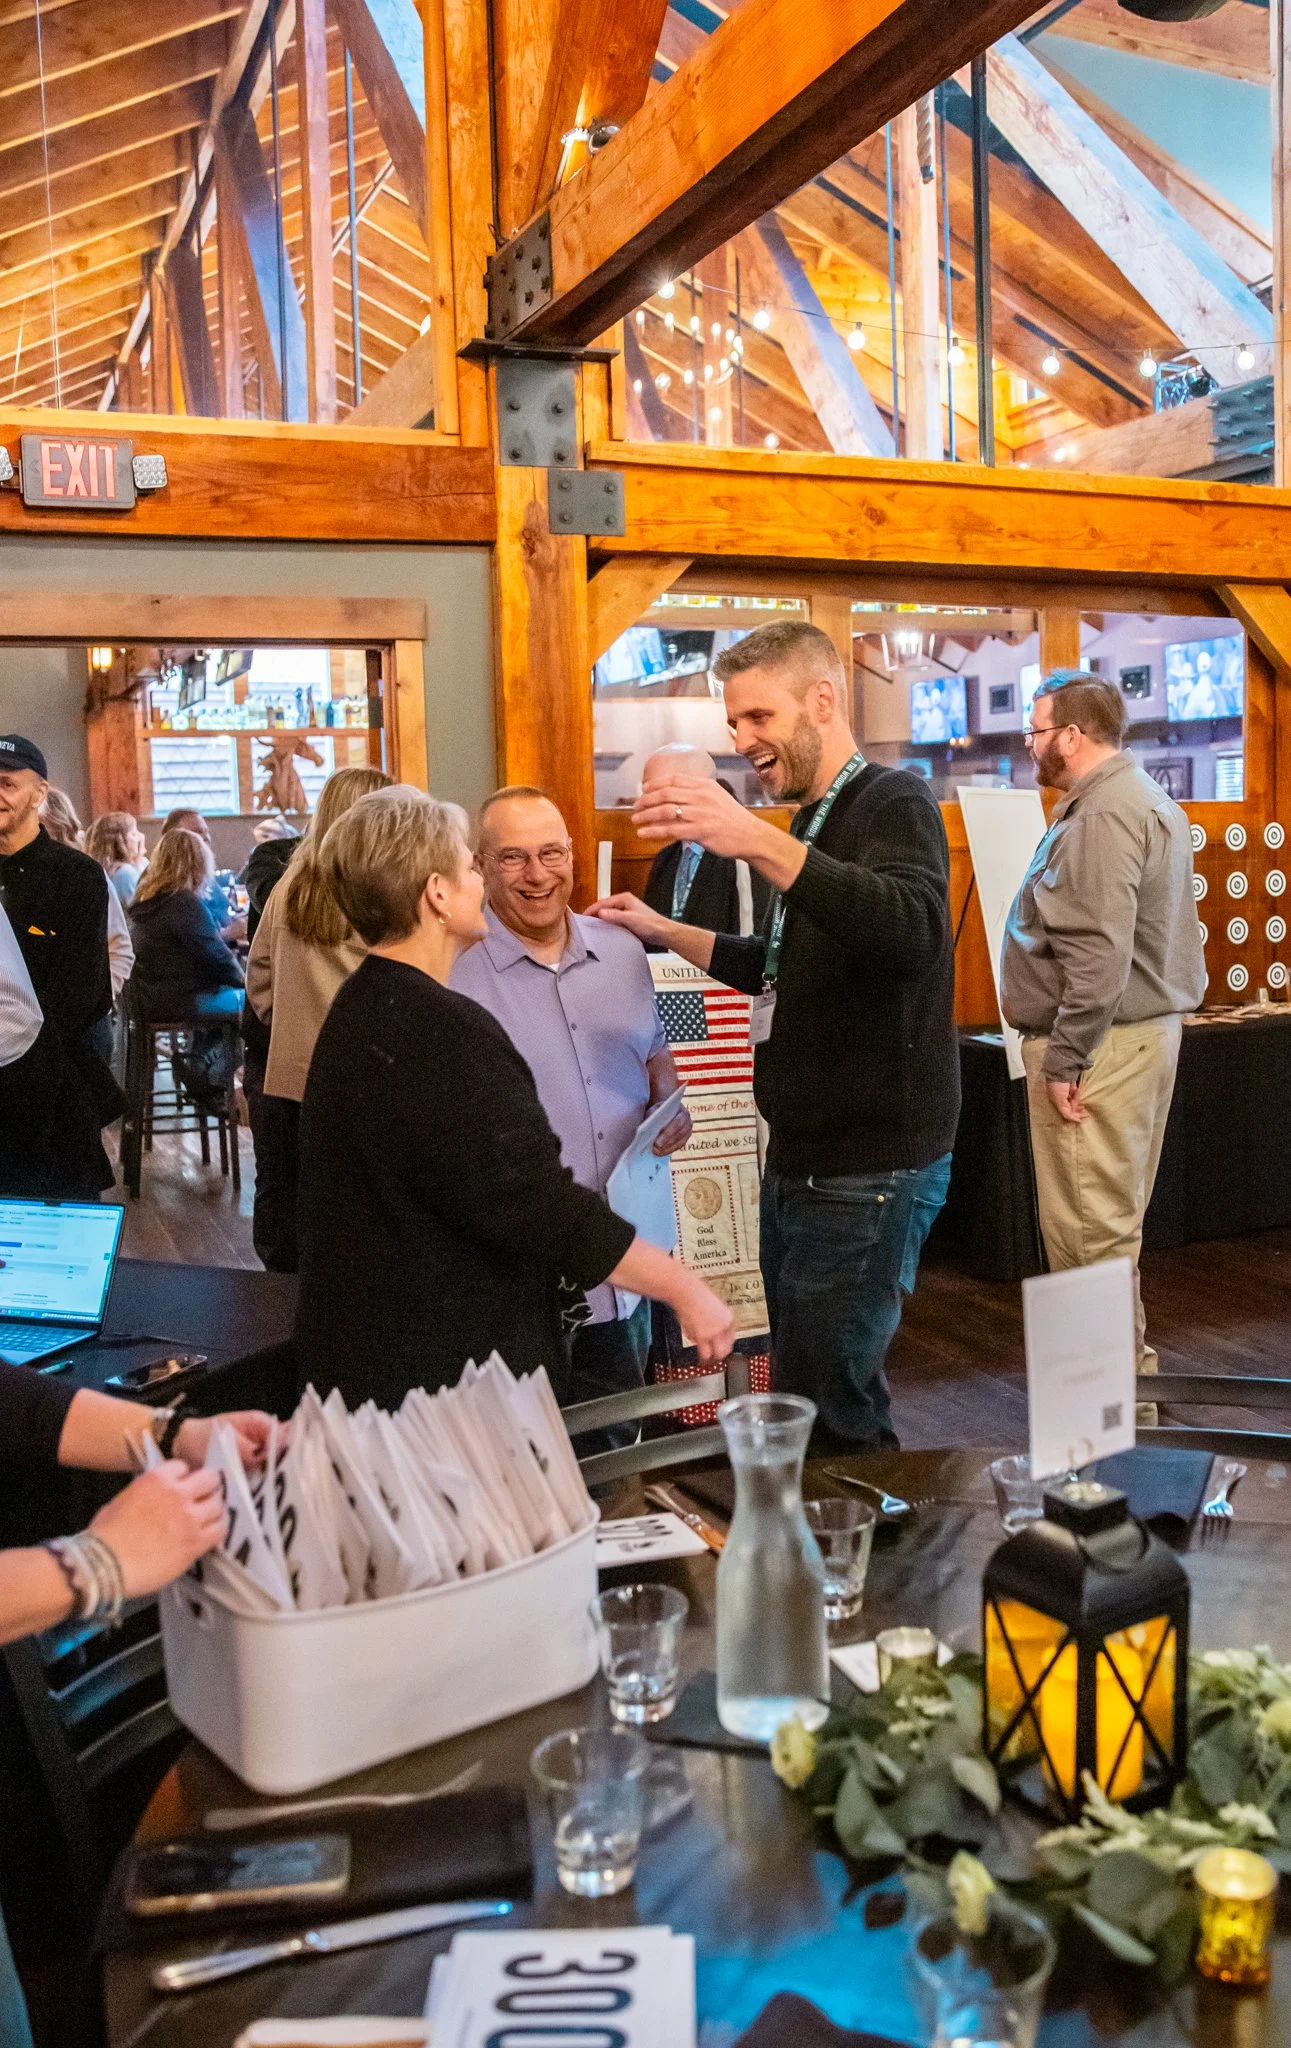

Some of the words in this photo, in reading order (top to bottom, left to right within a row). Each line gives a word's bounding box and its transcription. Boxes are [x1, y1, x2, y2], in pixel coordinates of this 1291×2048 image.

[40, 440, 118, 498] EXIT
[846, 761, 857, 772] THE
[832, 770, 850, 789] WOODS
[818, 803, 829, 816] THE
[808, 815, 823, 838] WOODS
[716, 1100, 729, 1112] of
[731, 1099, 748, 1109] the
[724, 1139, 739, 1147] we
[696, 1224, 714, 1234] God
[697, 1238, 717, 1248] Bless
[693, 1250, 727, 1261] America
